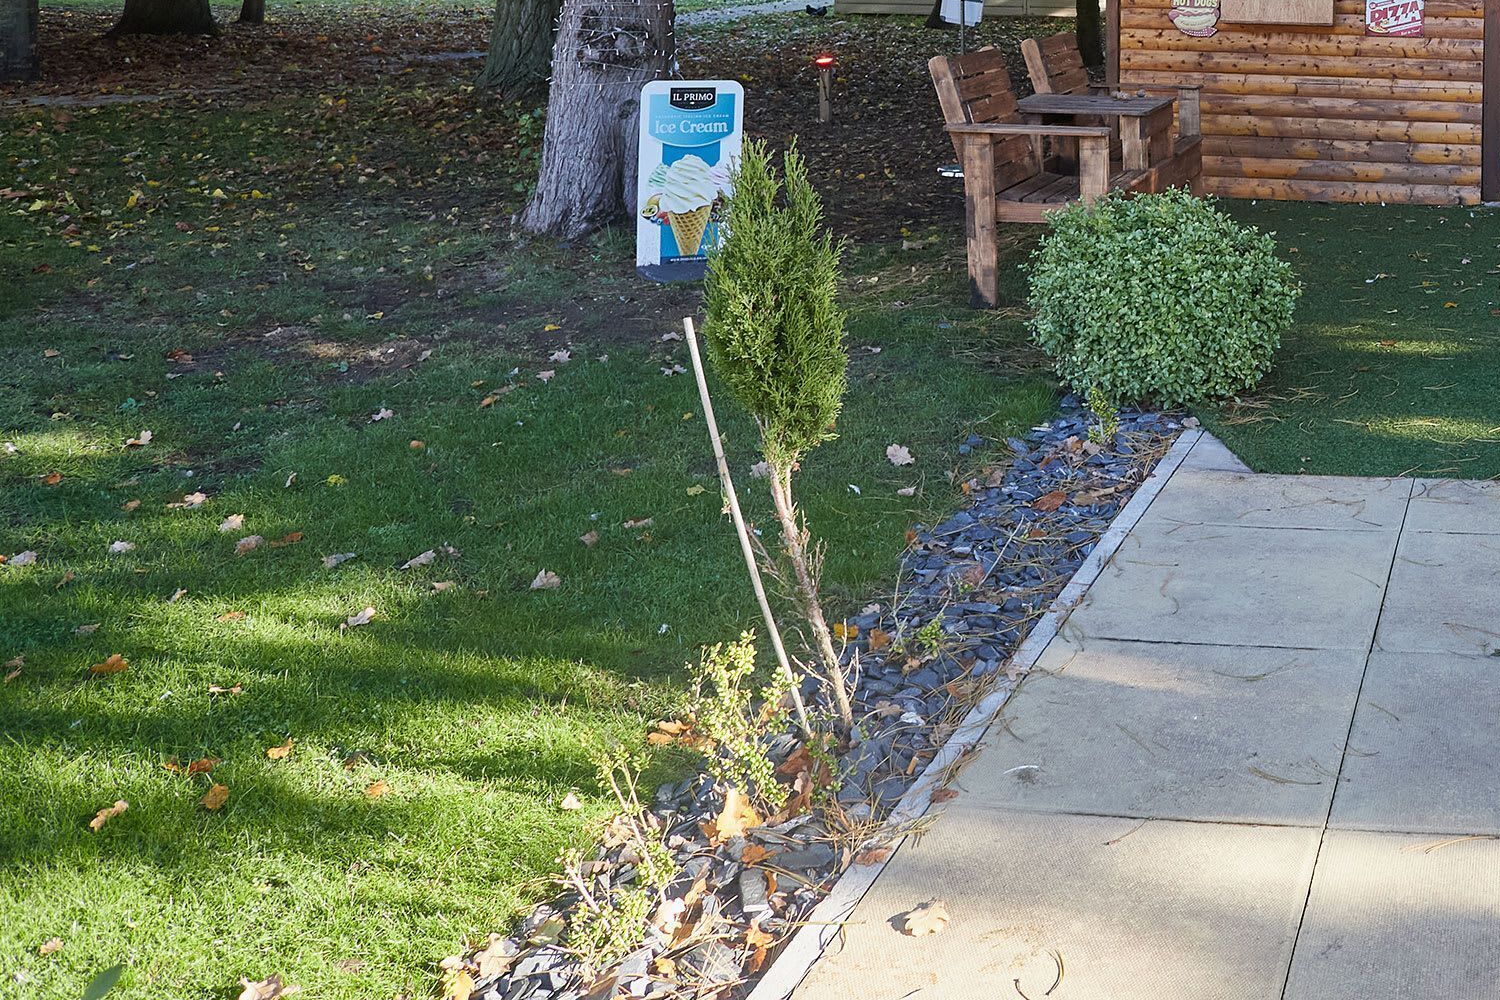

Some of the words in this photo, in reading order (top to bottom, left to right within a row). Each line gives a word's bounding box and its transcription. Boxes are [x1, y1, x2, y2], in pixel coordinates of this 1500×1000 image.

[1370, 1, 1421, 28] PIZZA
[673, 93, 682, 101] IL
[684, 93, 713, 101] PRIMO
[655, 120, 676, 134] Ice
[680, 119, 728, 133] Cream
